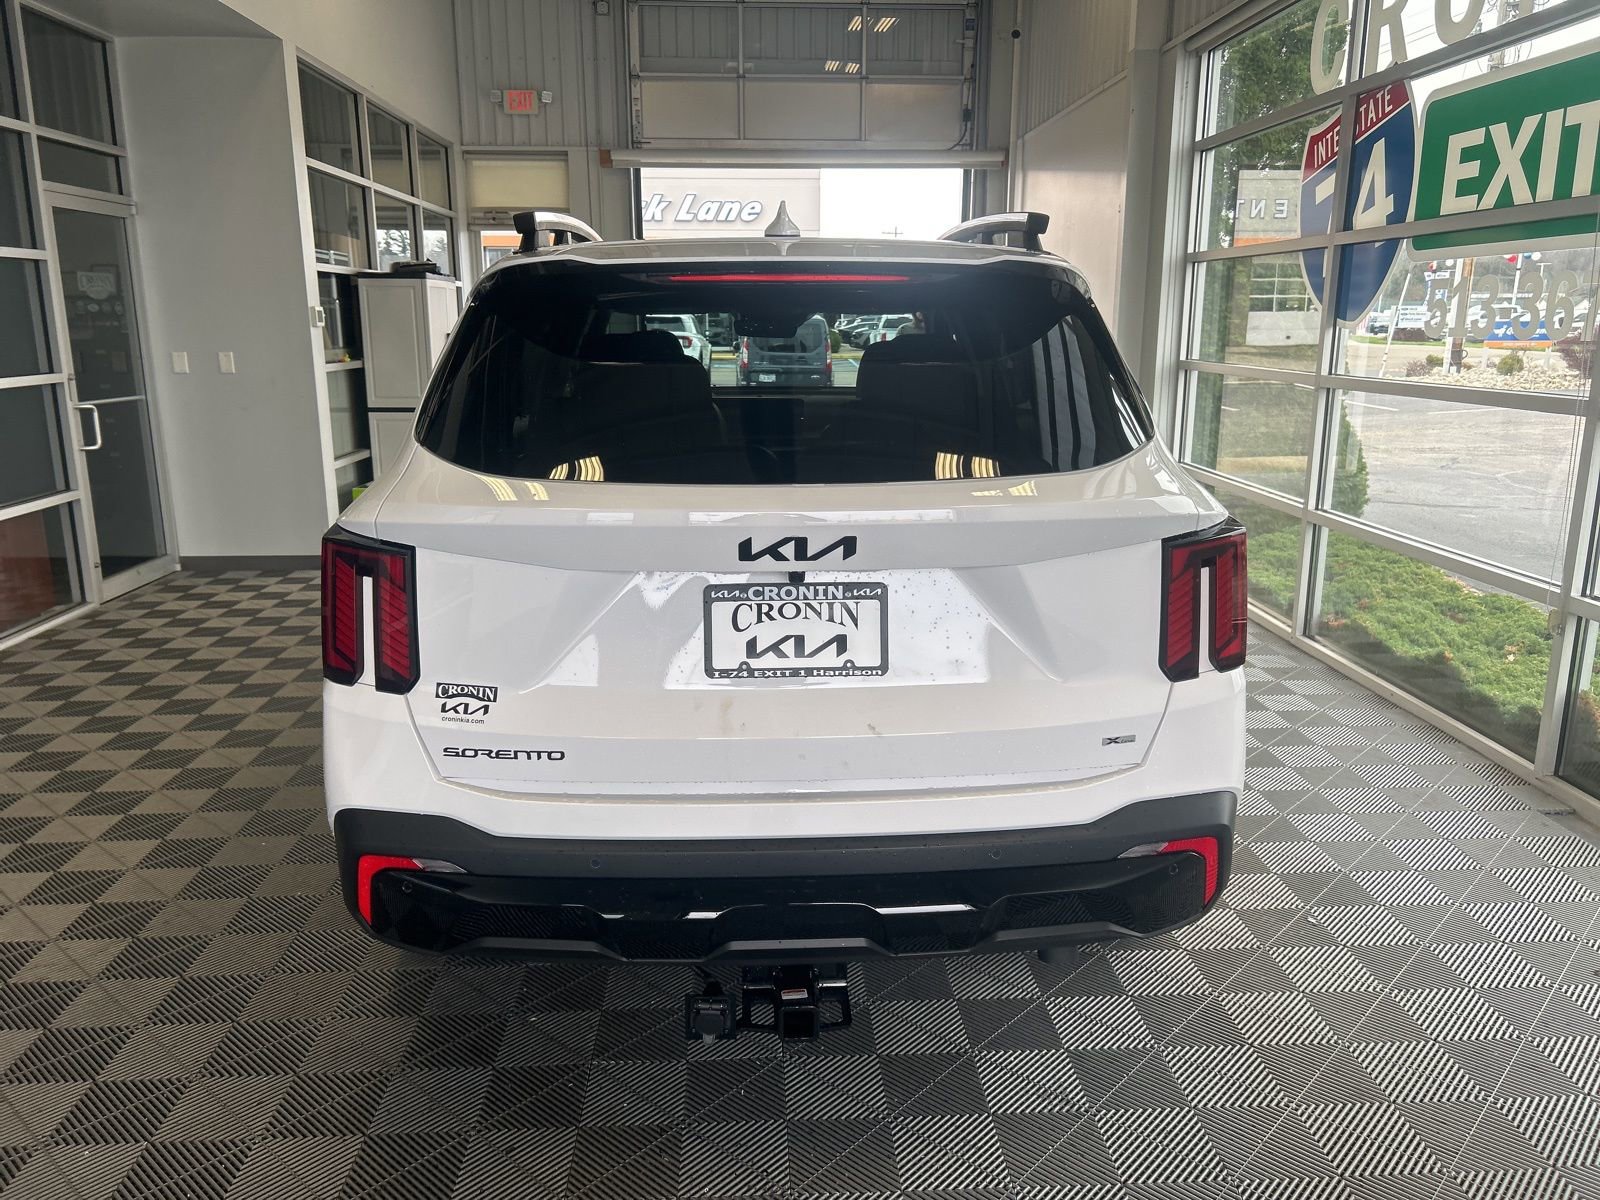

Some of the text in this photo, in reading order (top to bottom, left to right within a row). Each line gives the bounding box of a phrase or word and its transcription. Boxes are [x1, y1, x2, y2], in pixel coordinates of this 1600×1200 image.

[507, 90, 534, 112] EXIT
[1314, 84, 1393, 168] INTETATE
[1440, 100, 1600, 216] EXIT
[642, 193, 764, 223] k Lane
[738, 535, 858, 562] KIA
[711, 585, 882, 601] KIA CRONIN KIA
[731, 601, 861, 633] CRONIN
[746, 633, 848, 660] KIA
[712, 668, 882, 678] I-74 EXIT 1 Harrison
[438, 683, 496, 702] CRONIN
[440, 701, 490, 716] KIA
[441, 715, 485, 725] croninkia.com
[442, 746, 566, 761] SORENTO
